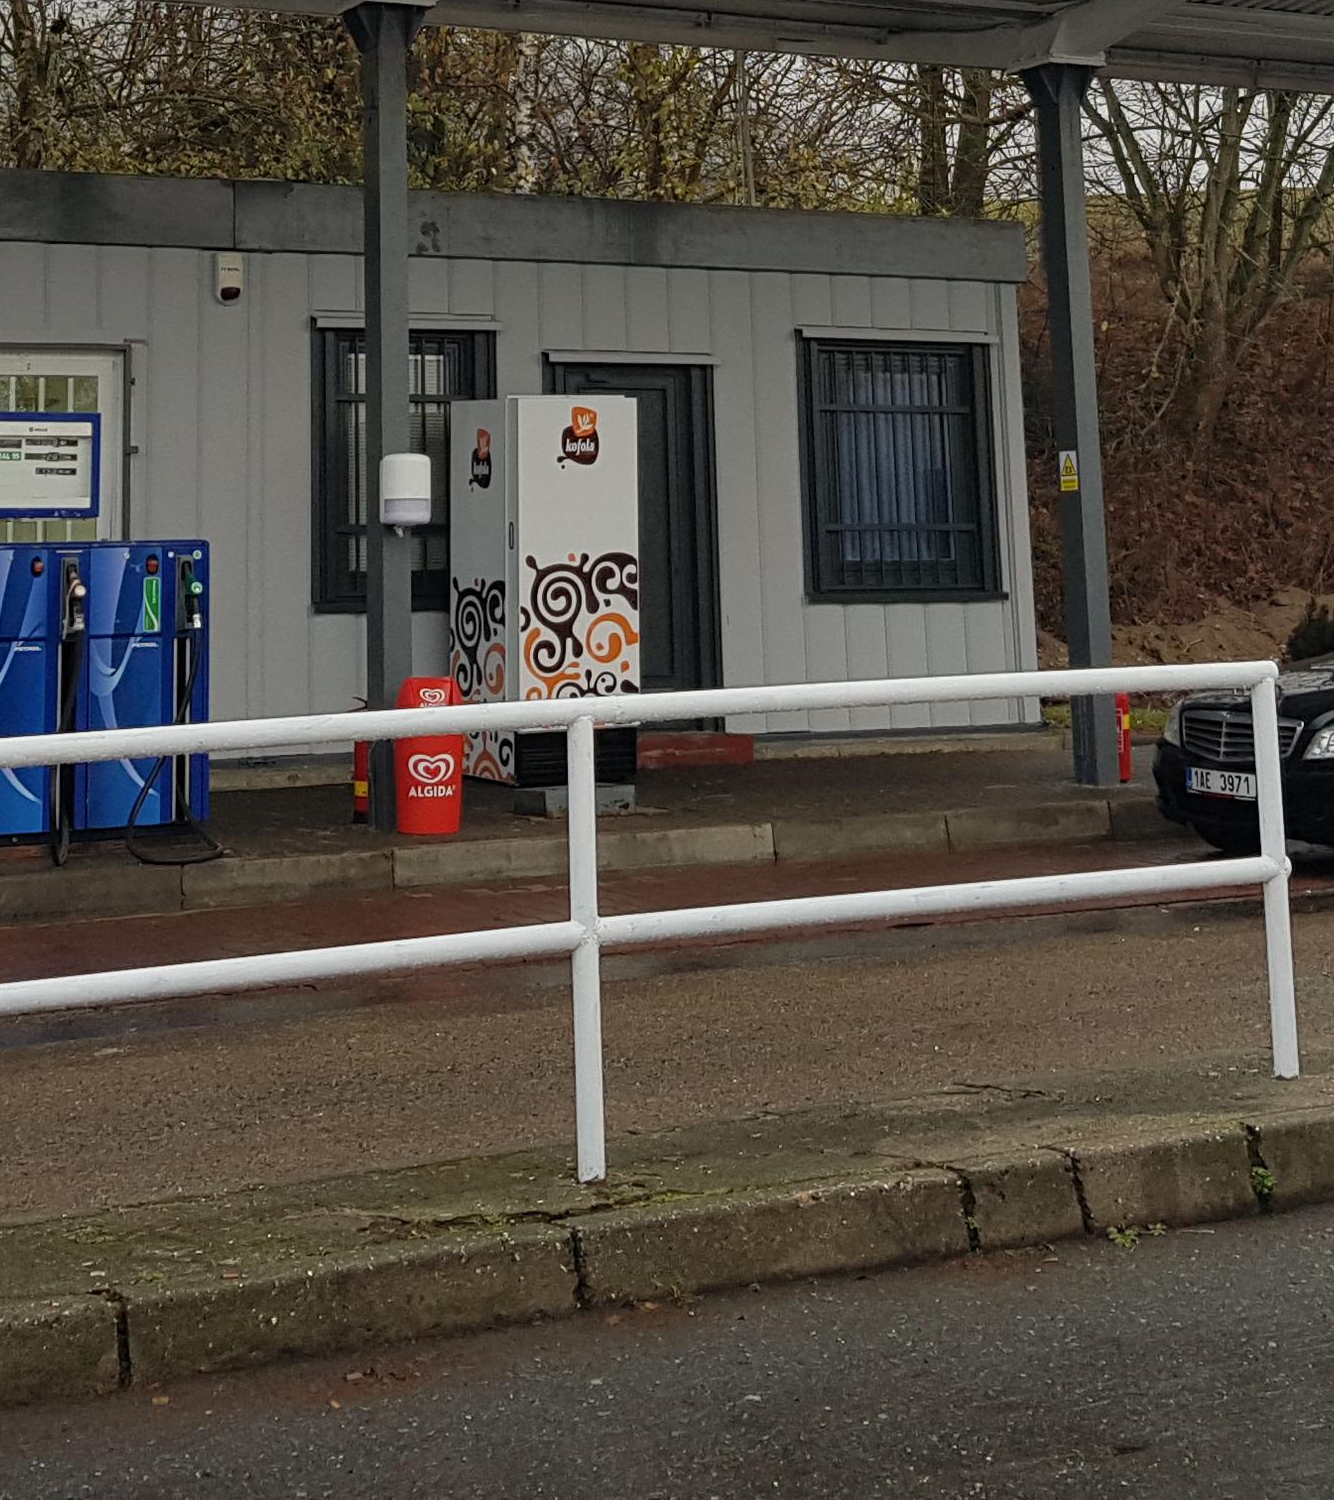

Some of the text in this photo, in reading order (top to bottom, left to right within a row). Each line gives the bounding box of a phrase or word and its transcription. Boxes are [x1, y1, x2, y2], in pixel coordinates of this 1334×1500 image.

[565, 438, 595, 456] kofola
[1194, 770, 1250, 794] 1AE 3971
[408, 785, 454, 798] ALGIDA
